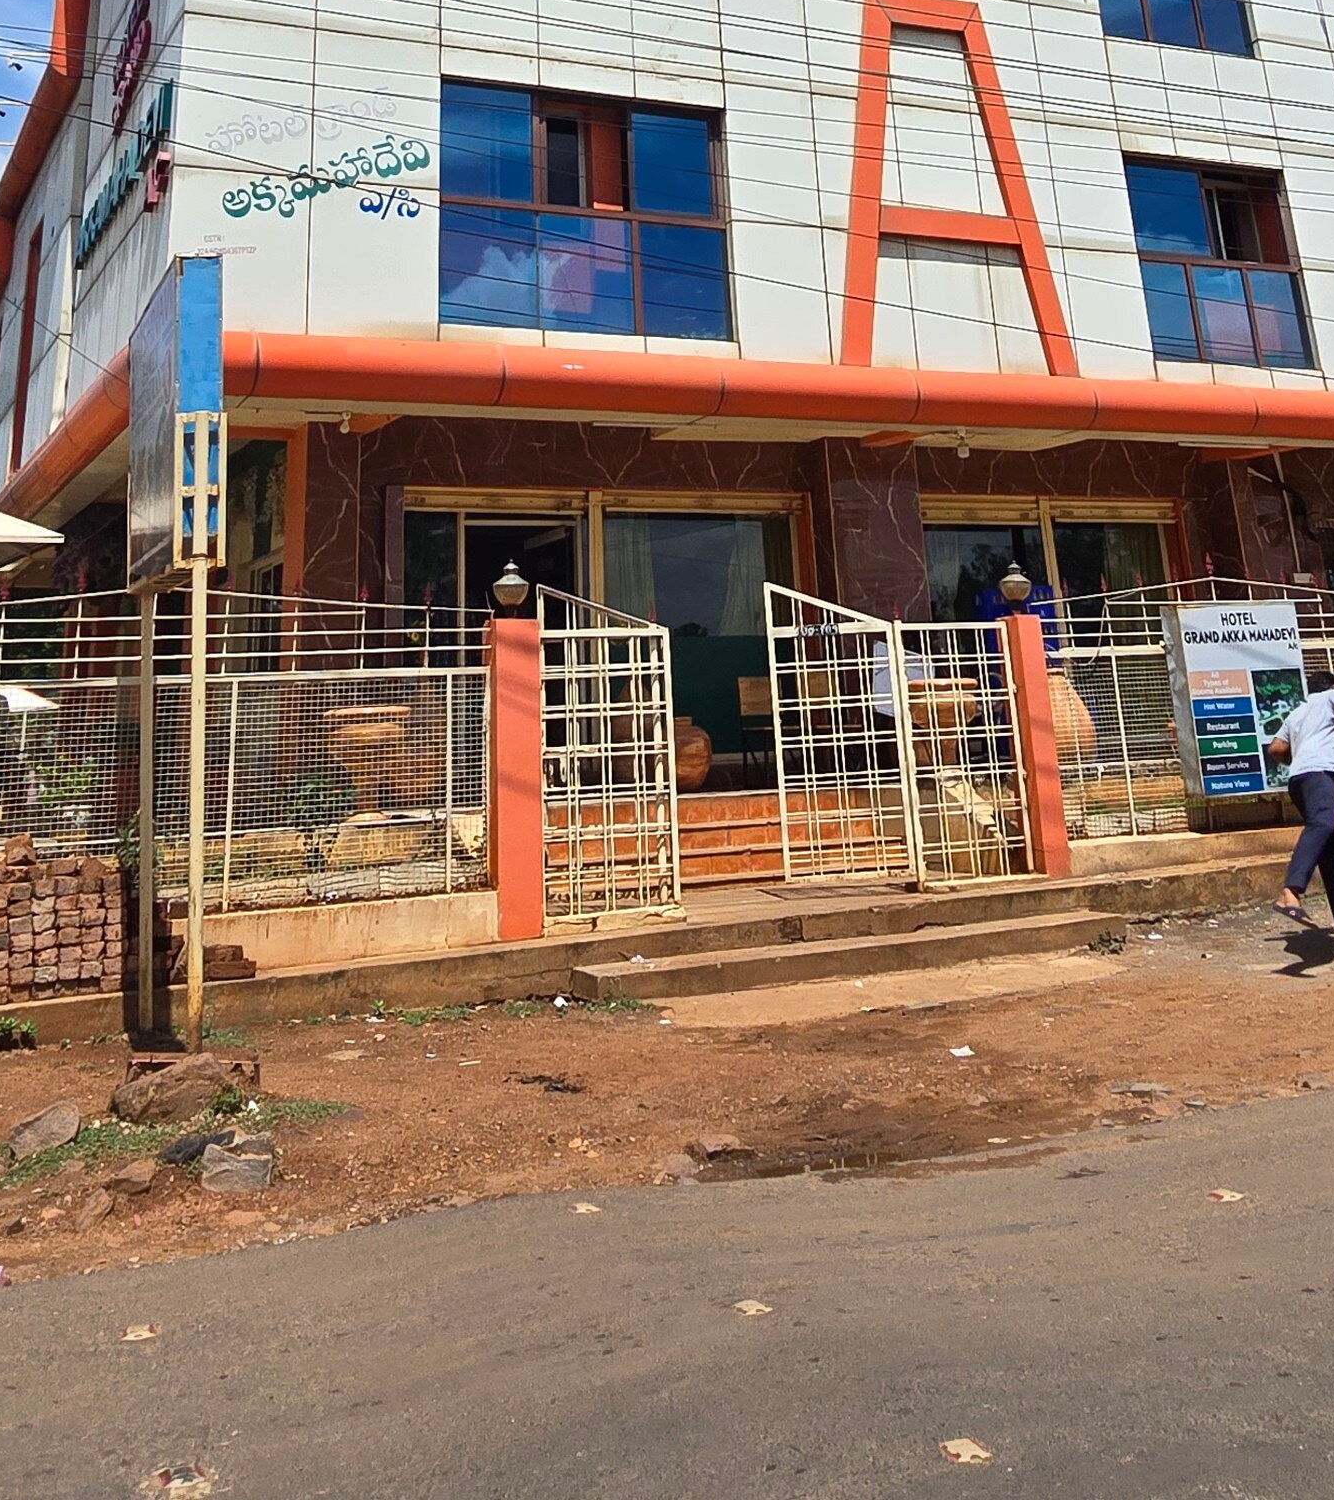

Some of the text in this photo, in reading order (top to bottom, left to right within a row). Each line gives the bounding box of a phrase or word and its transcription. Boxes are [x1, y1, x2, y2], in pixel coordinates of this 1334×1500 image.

[1220, 612, 1257, 626] HOTEL
[1184, 627, 1297, 644] GRAND AKKA MAHADEVI
[1206, 722, 1240, 731] Restaurant
[1212, 740, 1238, 749] Parking
[1207, 761, 1249, 771] Room Service
[1211, 779, 1250, 790] Nature View
